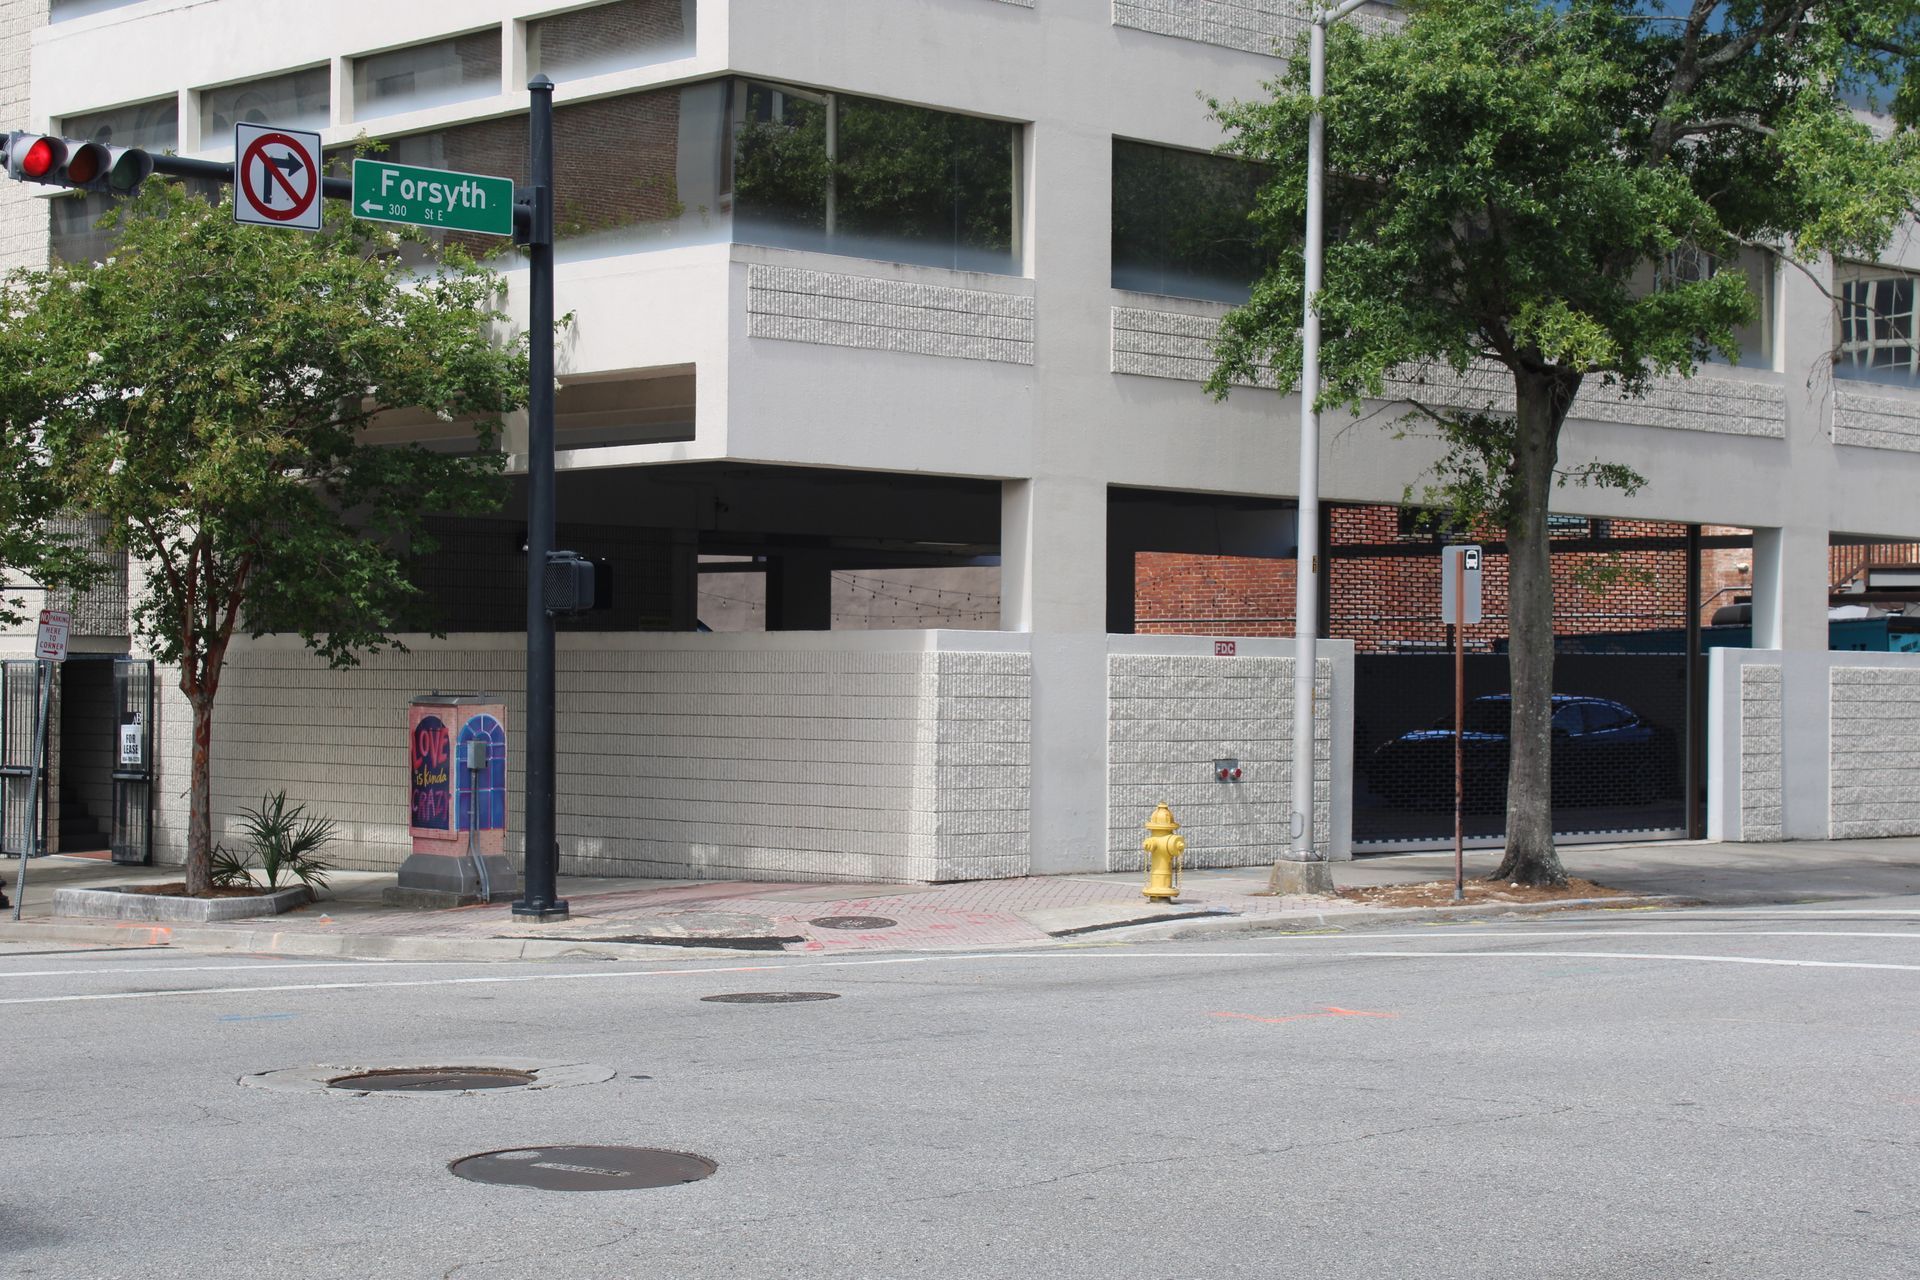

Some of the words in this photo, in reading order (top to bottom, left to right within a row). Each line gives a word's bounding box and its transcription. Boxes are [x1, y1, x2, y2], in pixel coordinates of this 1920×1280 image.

[381, 169, 486, 212] Forsyth
[388, 203, 407, 217] 300
[424, 208, 434, 220] St
[437, 210, 443, 221] E
[40, 611, 50, 622] NO
[50, 614, 69, 624] PARKING
[45, 627, 62, 635] HERE
[39, 641, 64, 650] CORNER
[1215, 643, 1234, 655] FDC
[125, 733, 137, 744] FOR
[123, 744, 139, 755] LEASE
[411, 727, 449, 768] LOVE
[411, 788, 452, 821] CRAZY
